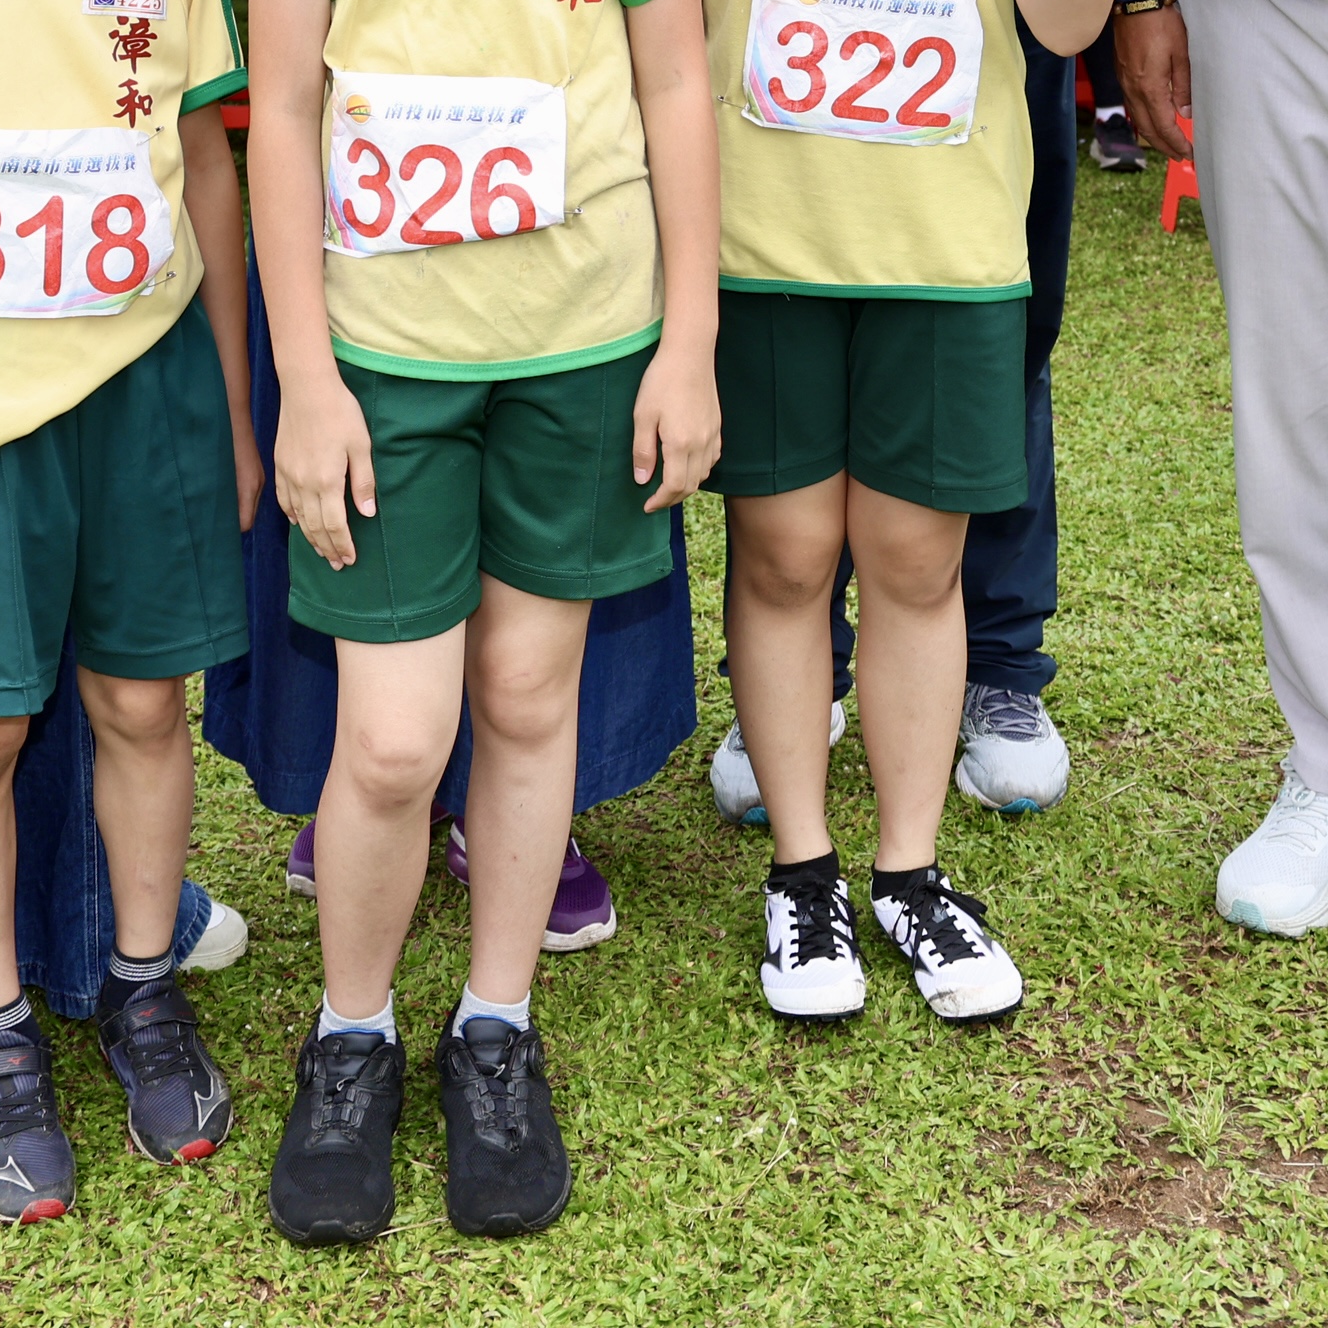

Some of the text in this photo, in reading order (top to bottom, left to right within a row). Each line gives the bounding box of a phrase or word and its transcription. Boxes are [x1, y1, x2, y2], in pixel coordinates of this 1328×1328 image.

[108, 15, 158, 129] 漳和
[767, 20, 957, 128] 322
[1, 153, 136, 175] 南投市運選拔賽
[342, 138, 537, 246] 326
